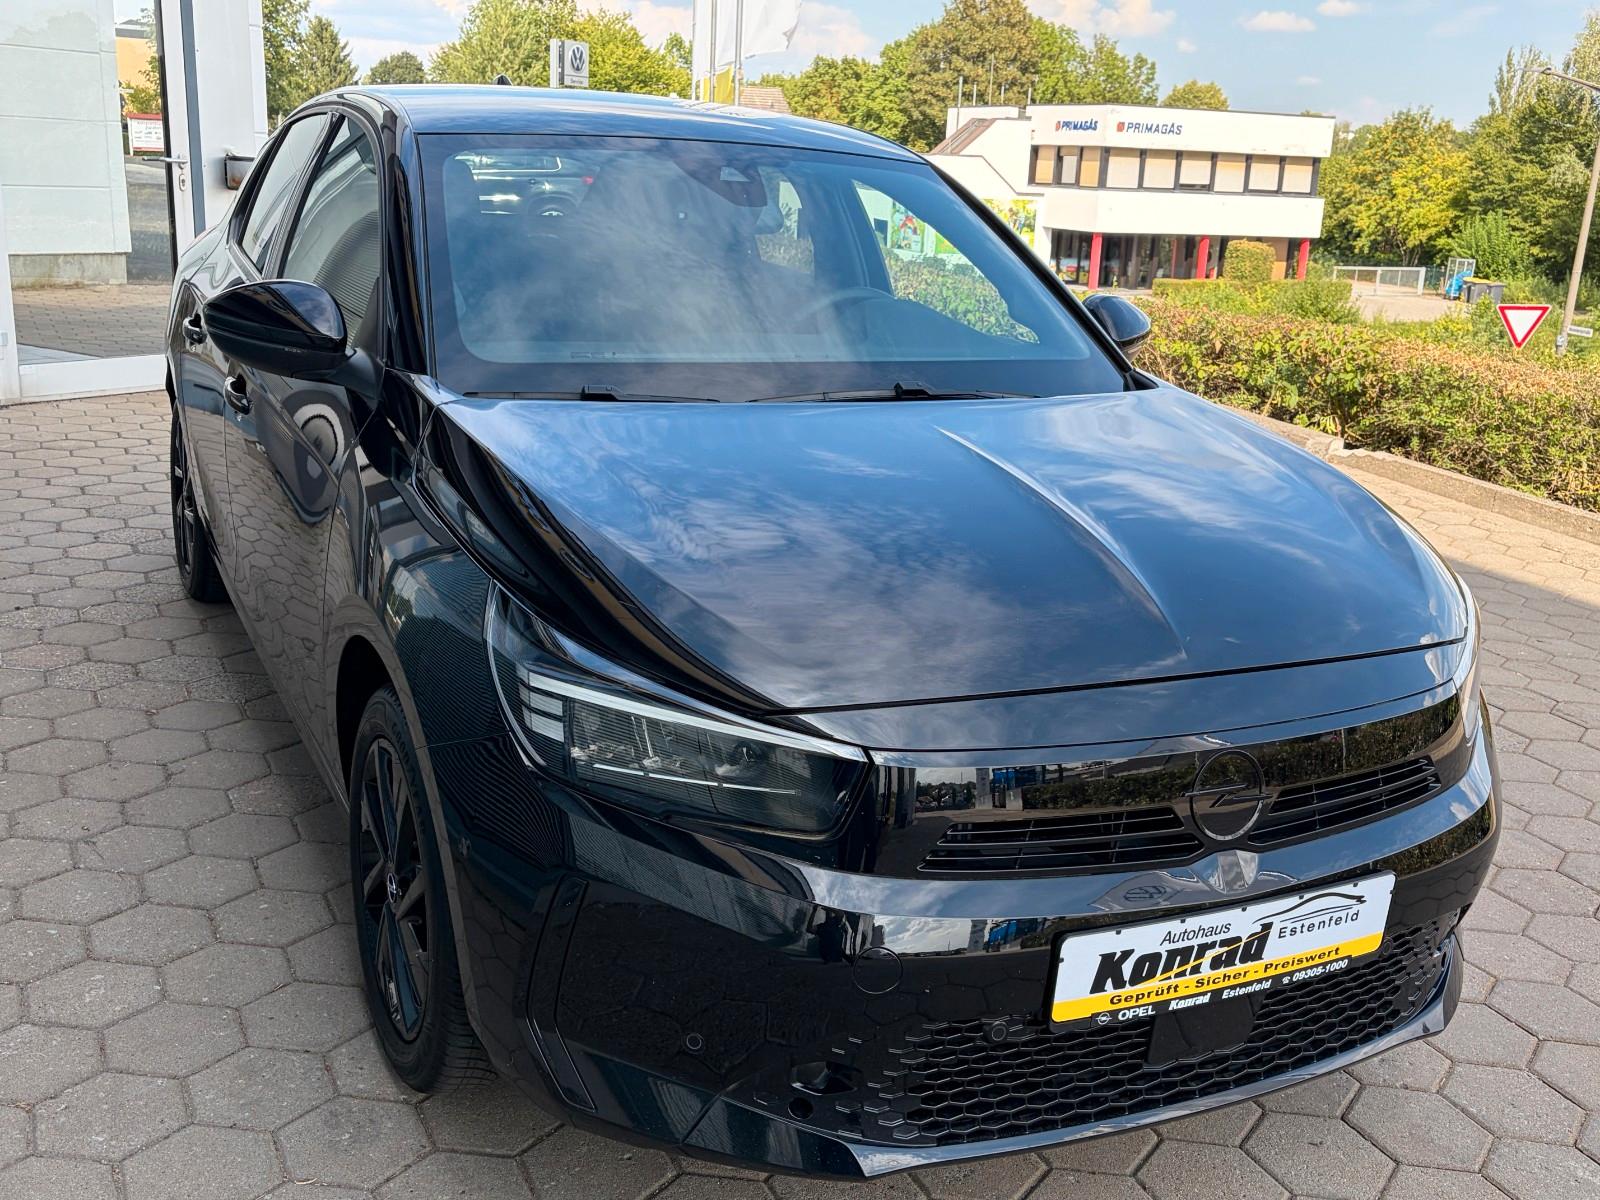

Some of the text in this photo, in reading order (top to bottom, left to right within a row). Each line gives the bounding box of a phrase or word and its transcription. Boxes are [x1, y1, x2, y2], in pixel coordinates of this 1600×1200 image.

[1126, 122, 1183, 135] PRIMAGAS
[1160, 922, 1232, 946] Autohaus
[1278, 909, 1360, 939] Estenfeld
[1089, 921, 1274, 994] Konrad
[1109, 983, 1180, 1005] Geprüft
[1194, 970, 1250, 988] Sicher
[1263, 947, 1340, 973] Preiswert
[1118, 959, 1349, 1021] OPEL Konrad Estenfeld 09305-1000
